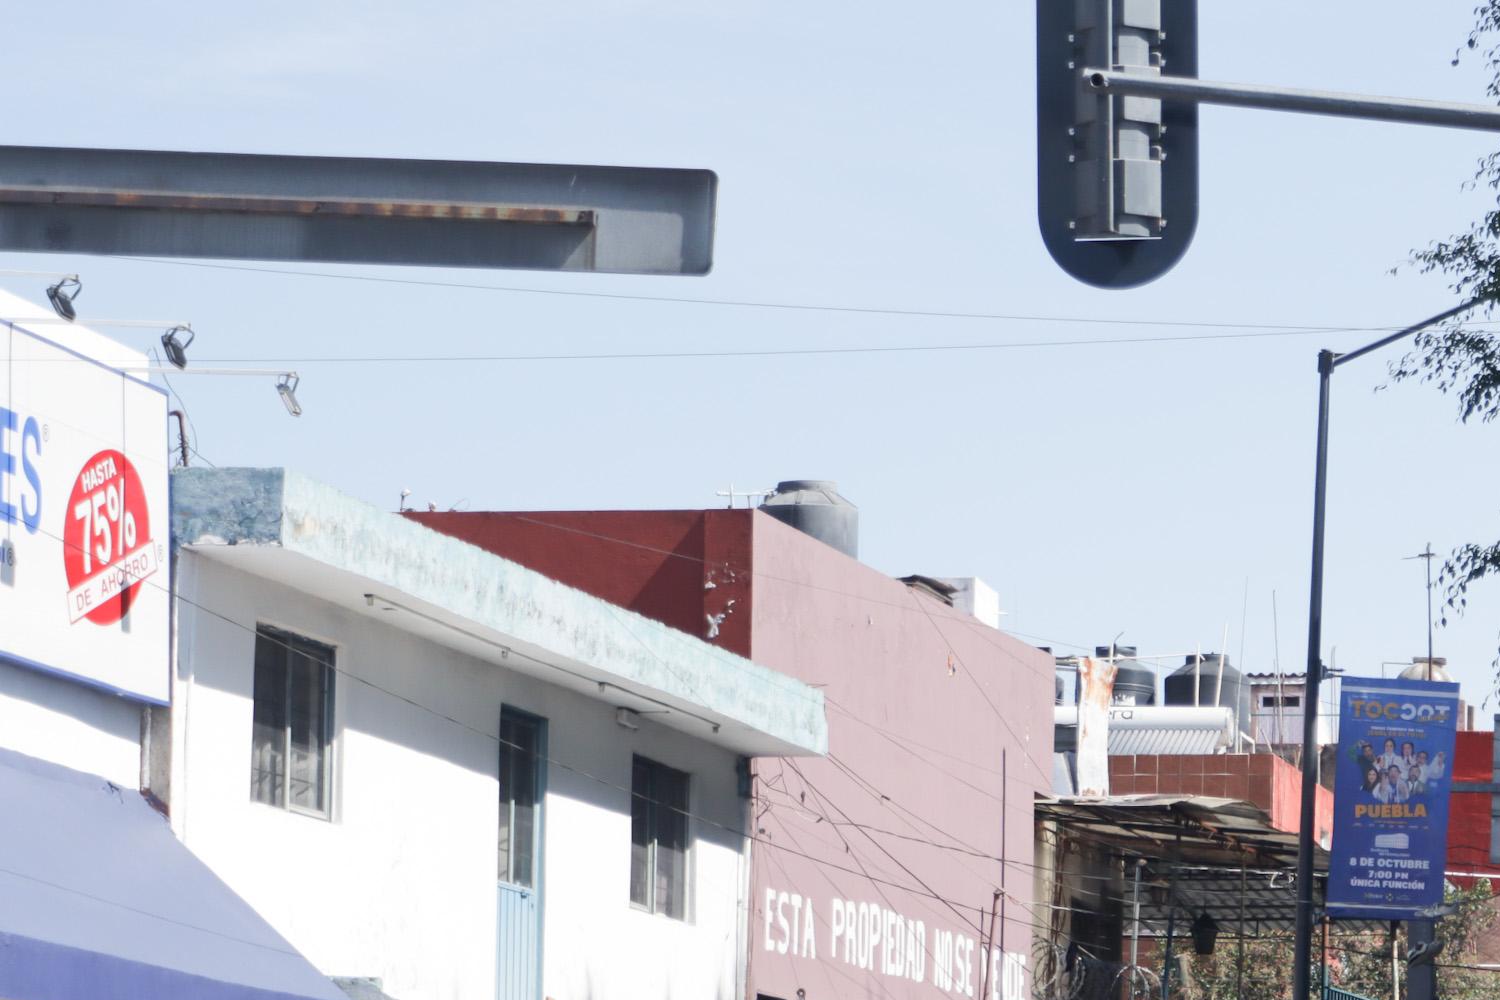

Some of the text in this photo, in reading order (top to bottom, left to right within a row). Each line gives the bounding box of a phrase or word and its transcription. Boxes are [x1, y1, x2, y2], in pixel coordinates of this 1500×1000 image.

[82, 457, 117, 494] HASTA
[74, 477, 136, 575] 75%
[76, 552, 149, 612] DE AHORRO
[1352, 699, 1399, 719] TOC
[1354, 803, 1428, 818] PUEBLA
[1349, 857, 1430, 869] 8 DE OCTUBRE
[1350, 876, 1425, 890] ÚNICA FUNCIÓN
[1368, 870, 1393, 879] 7:00
[765, 887, 816, 960] ESTA
[831, 897, 926, 984] PROPIEDAD
[934, 927, 952, 993] NO
[955, 936, 975, 998] SE
